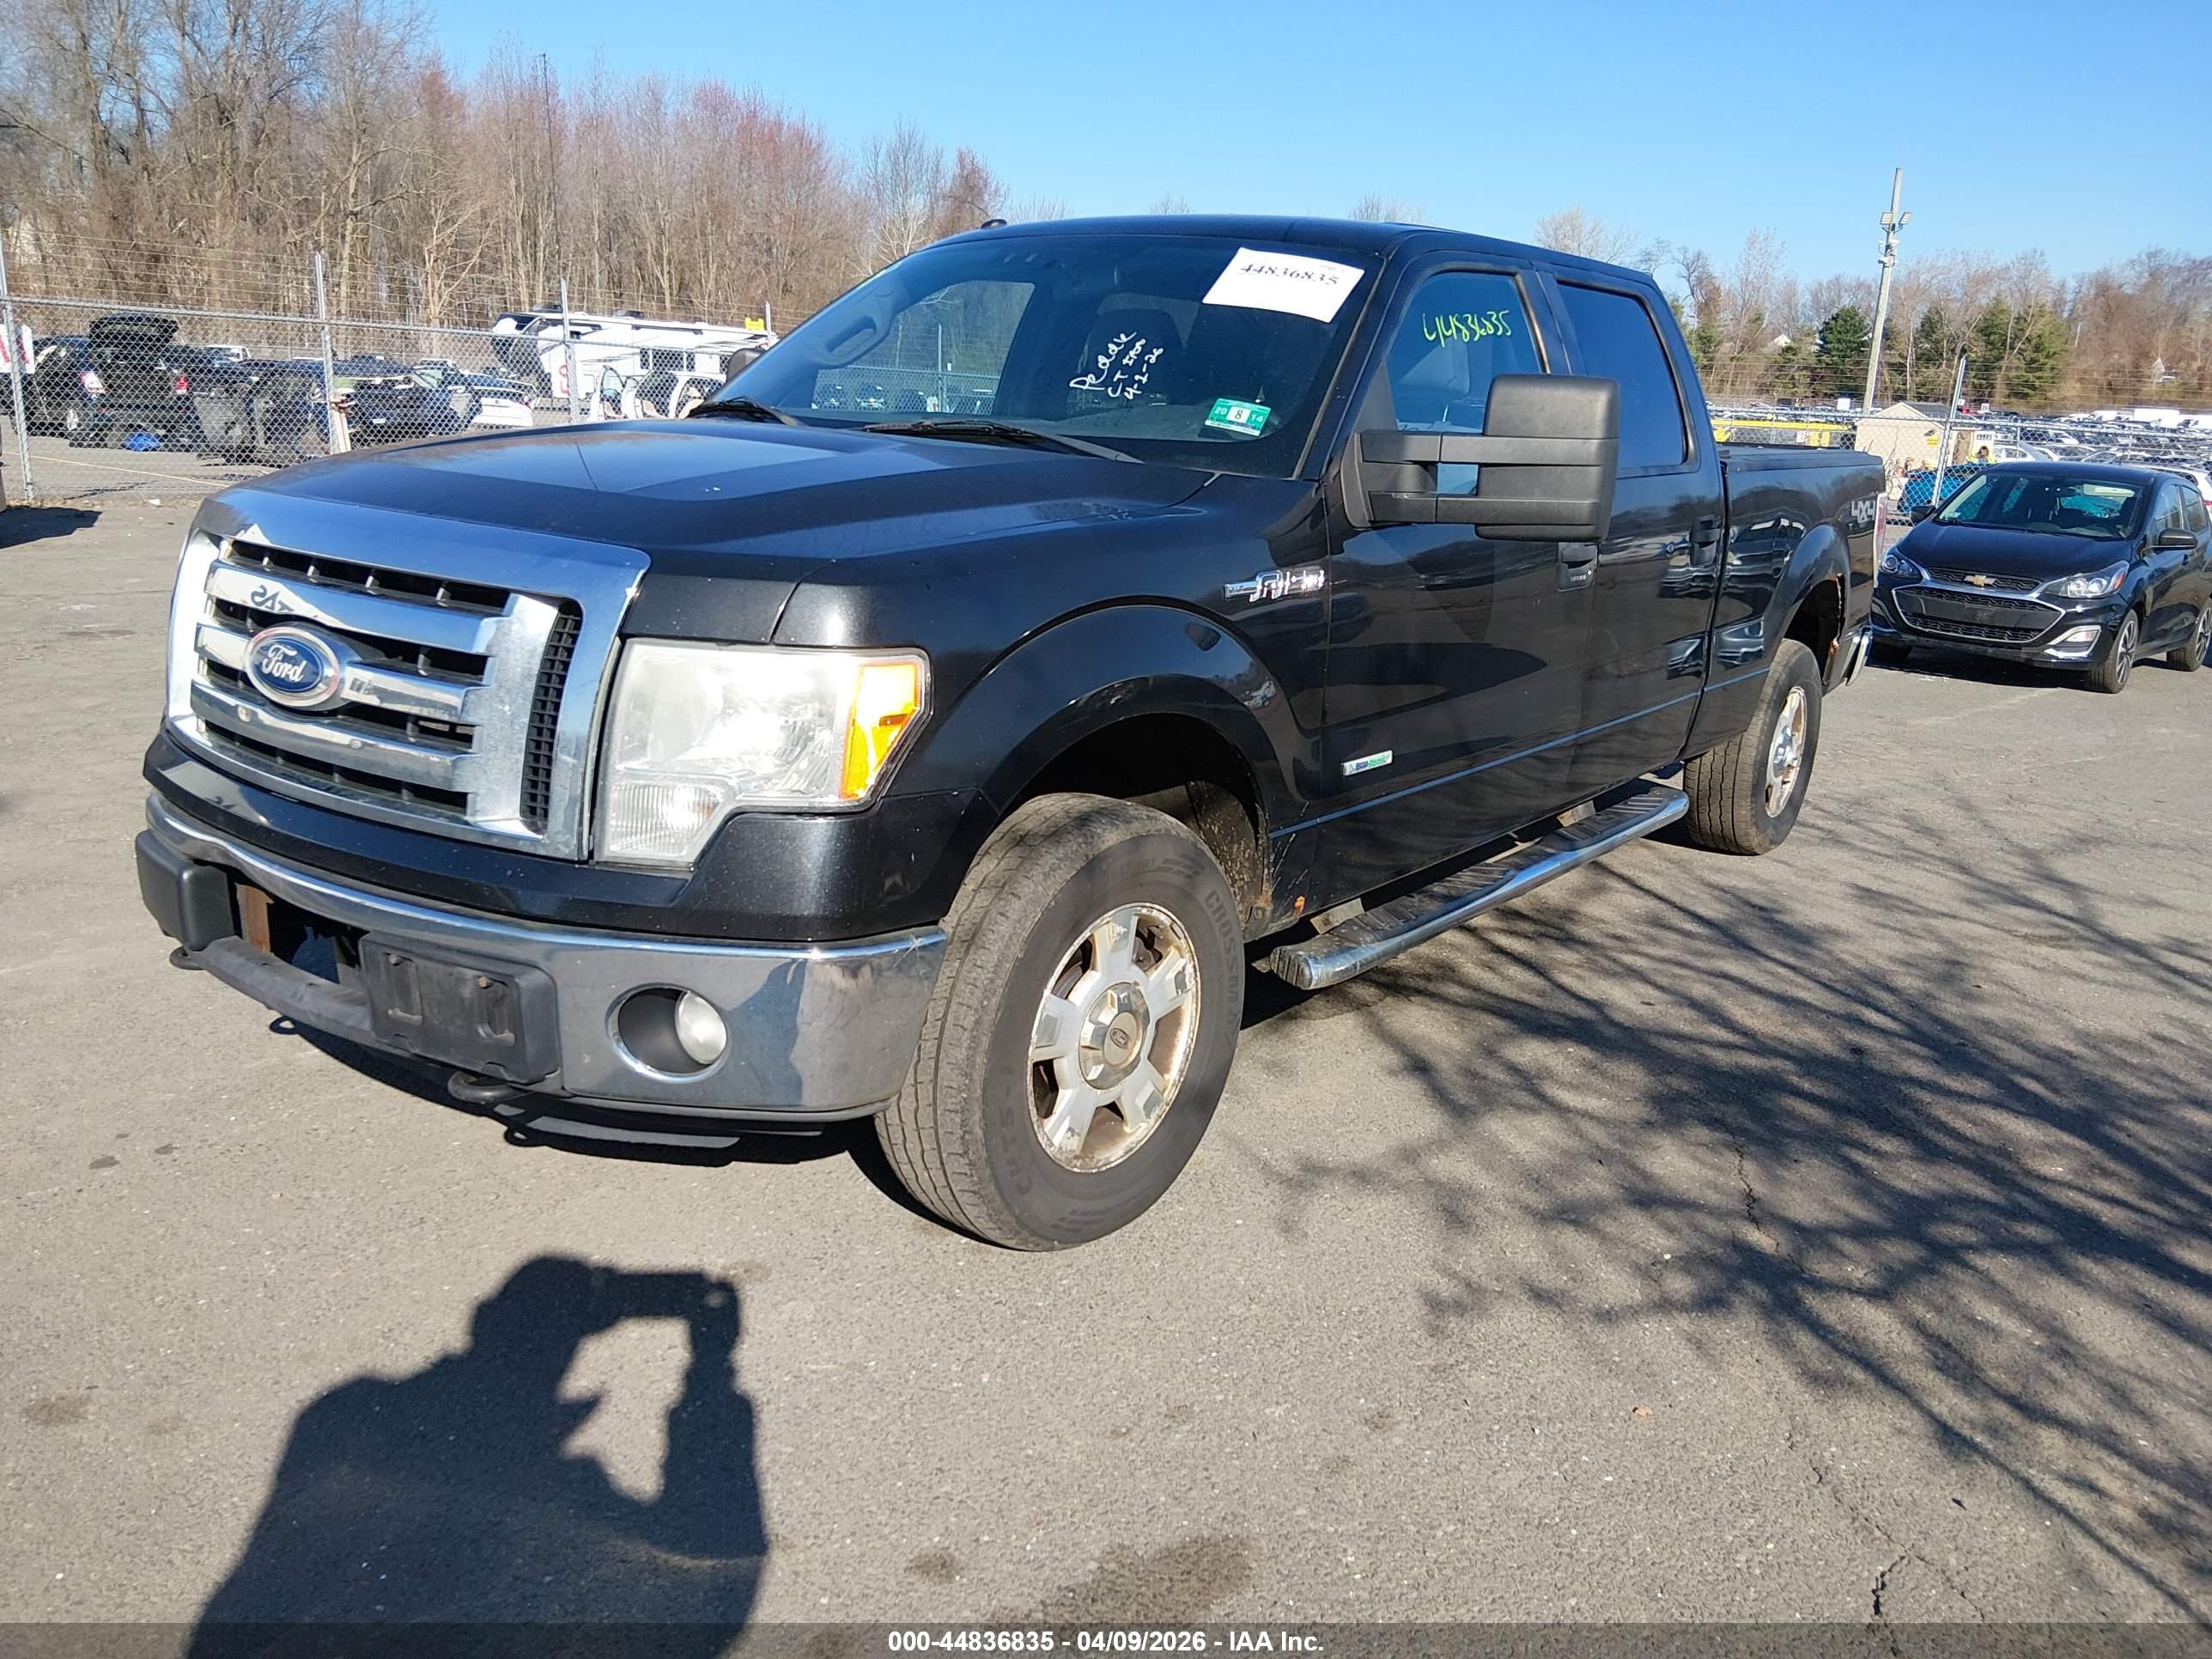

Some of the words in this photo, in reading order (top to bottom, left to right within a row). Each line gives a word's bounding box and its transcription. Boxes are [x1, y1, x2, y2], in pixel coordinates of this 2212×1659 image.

[1422, 310, 1512, 348] 44836835
[1235, 410, 1243, 419] 8
[261, 643, 307, 683] Ford
